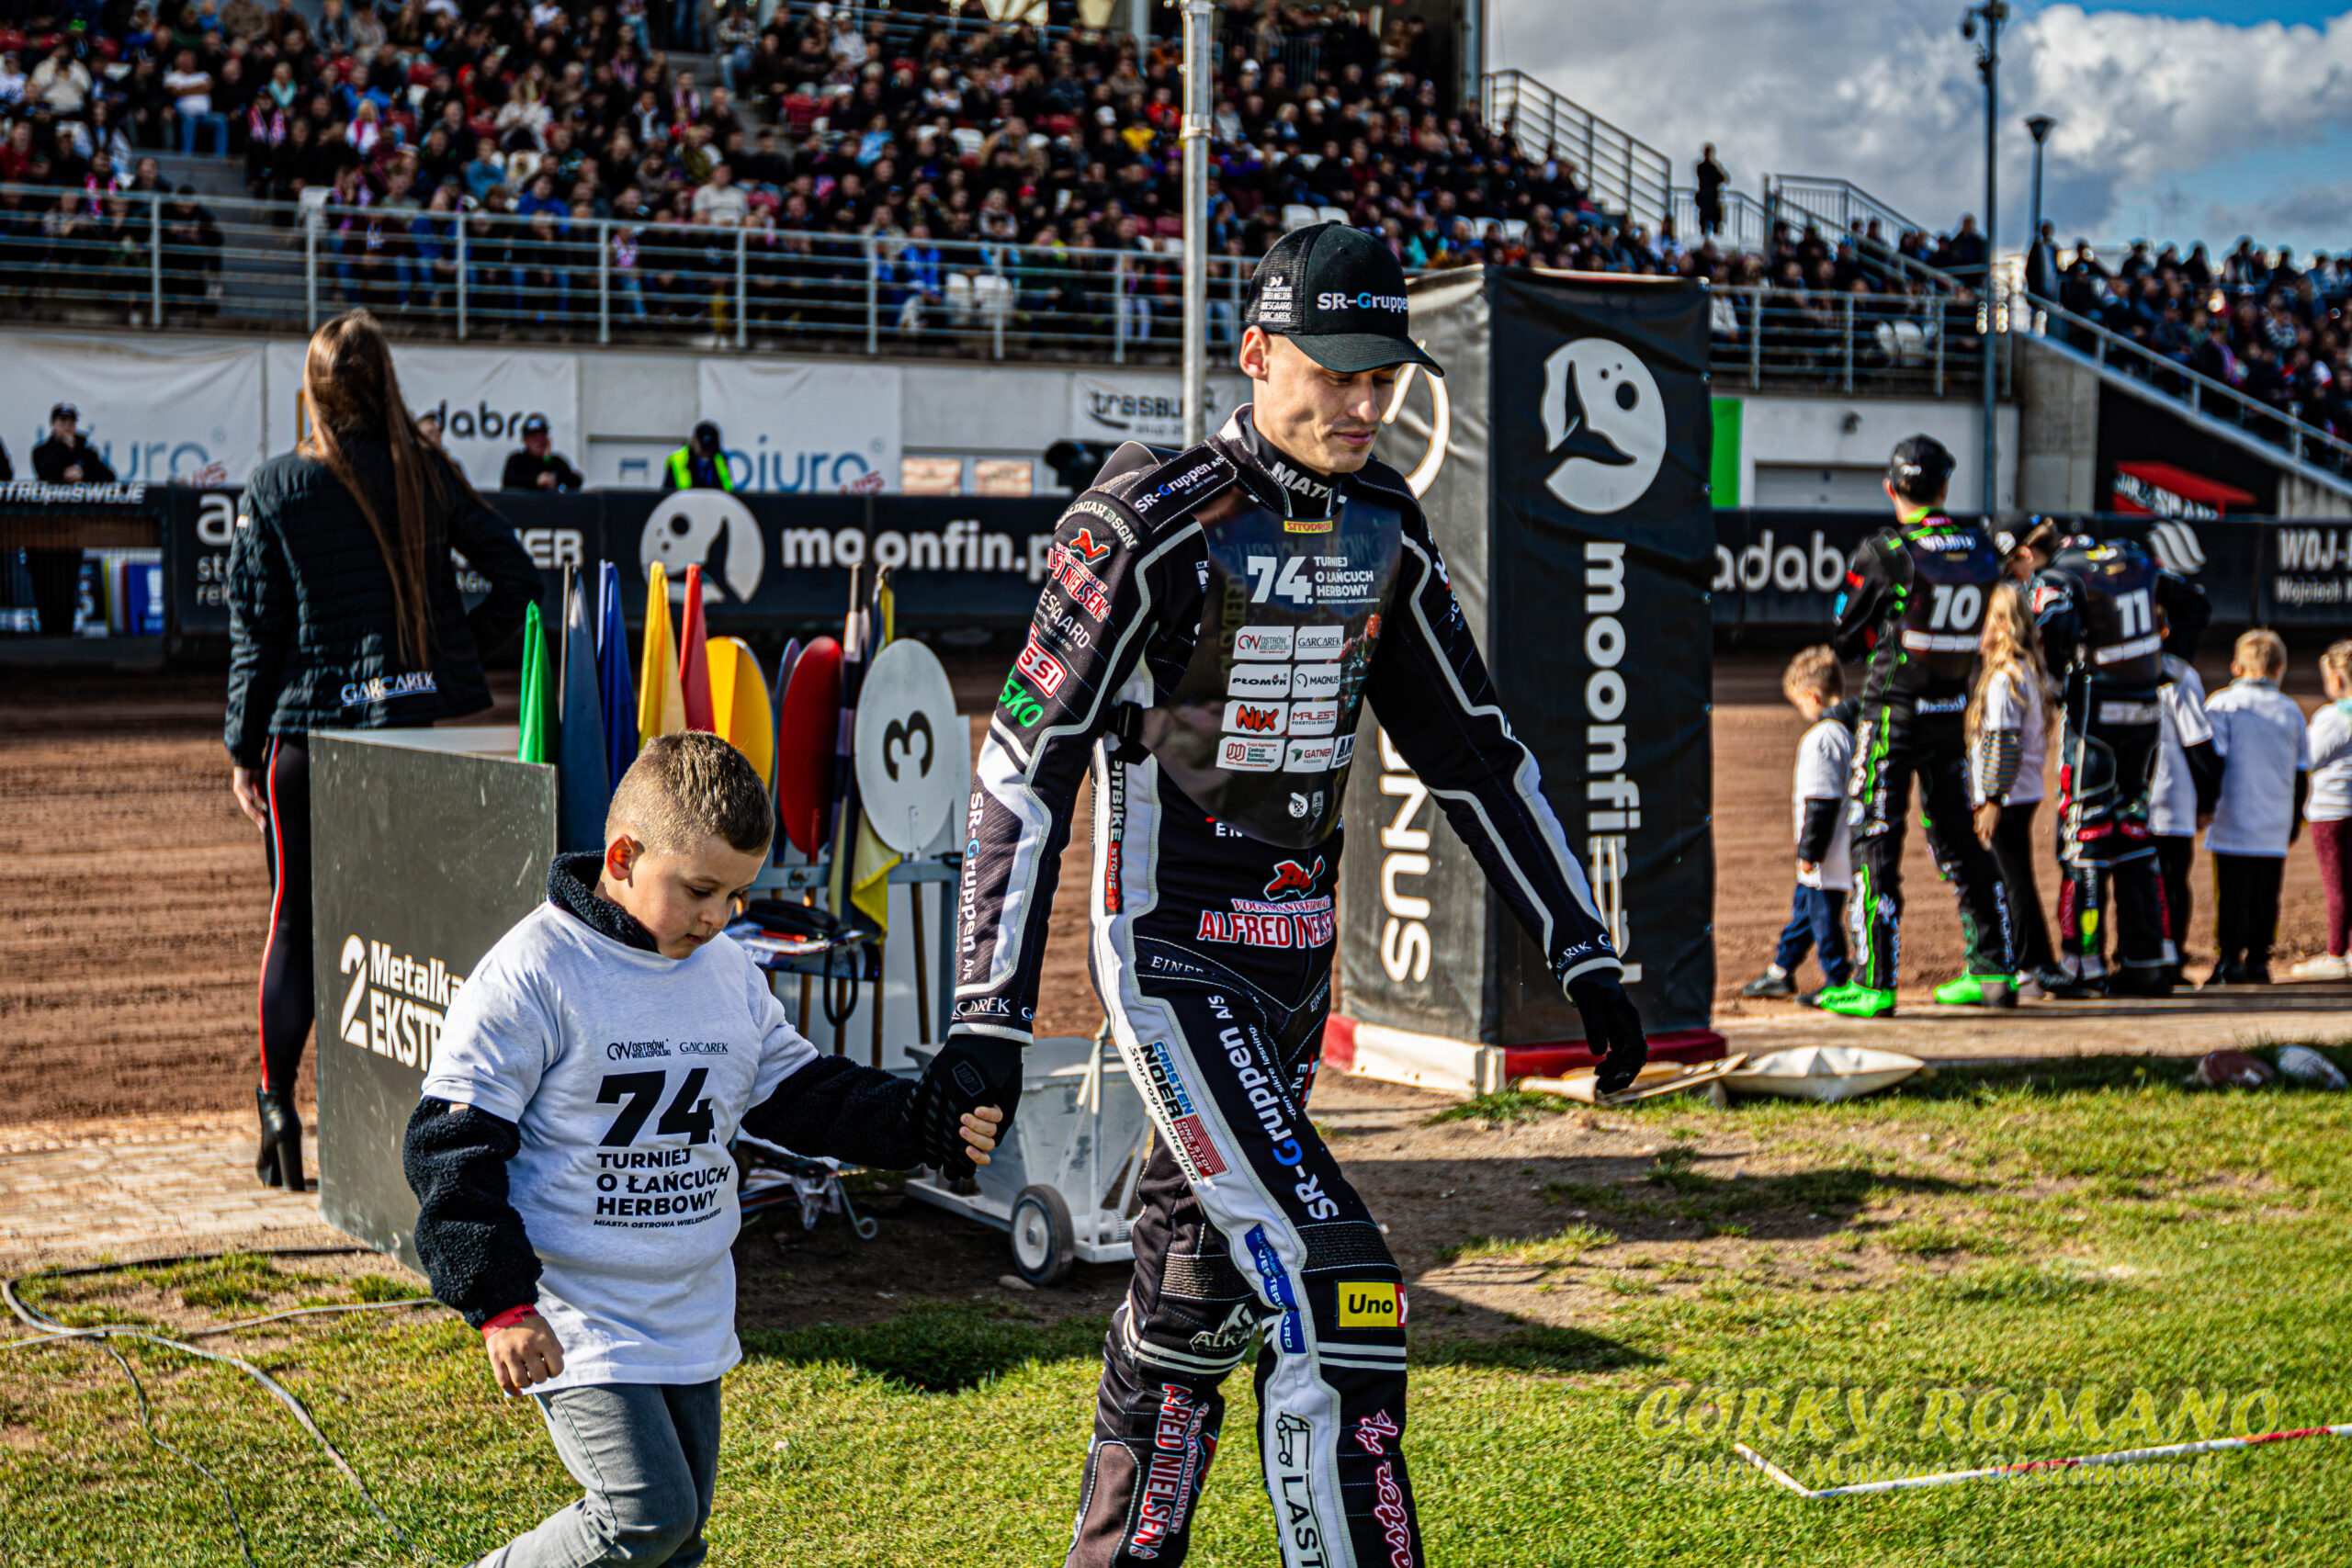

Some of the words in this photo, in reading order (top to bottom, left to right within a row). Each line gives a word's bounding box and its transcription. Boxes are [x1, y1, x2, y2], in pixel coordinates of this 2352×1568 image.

[1135, 463, 1212, 513] SR-Gruppen
[1272, 461, 1331, 498] MAT
[1314, 556, 1348, 567] TURNIEJ
[1315, 571, 1324, 582] O
[1326, 568, 1374, 583] ŁAŃCUCH
[1317, 584, 1368, 597] HERBOWY
[1930, 584, 1982, 630] 10
[2116, 588, 2152, 638] 11
[1297, 637, 1341, 647] GARCAREK
[341, 671, 436, 705] GARCAREK
[1309, 675, 1340, 685] MAGNUS
[1236, 704, 1280, 732] NIX
[883, 710, 934, 783] 3
[1305, 749, 1332, 759] GATNER
[961, 792, 984, 952] SR-Gruppen
[1197, 910, 1293, 948] ALFRED
[341, 934, 368, 1049] 2
[1207, 995, 1233, 1020] A/S
[631, 1049, 672, 1059] WIELKOPOLSKI
[632, 1039, 664, 1052] OSTRÓW
[1153, 1041, 1195, 1115] CARSTEN
[1218, 1026, 1340, 1220] SR-Gruppen
[596, 1148, 691, 1168] TURNIEJ
[1175, 1122, 1204, 1168] SERVICE
[1181, 1121, 1195, 1142] ONE
[1193, 1145, 1214, 1174] STOP
[596, 1173, 617, 1191] O
[626, 1166, 730, 1194] ŁAŃCUCH
[596, 1189, 718, 1216] HERBOWY
[594, 1219, 628, 1228] MIASTA
[631, 1219, 674, 1228] OSTROWA
[1349, 1293, 1393, 1314] Uno
[1131, 1452, 1184, 1549] NIELSEN
